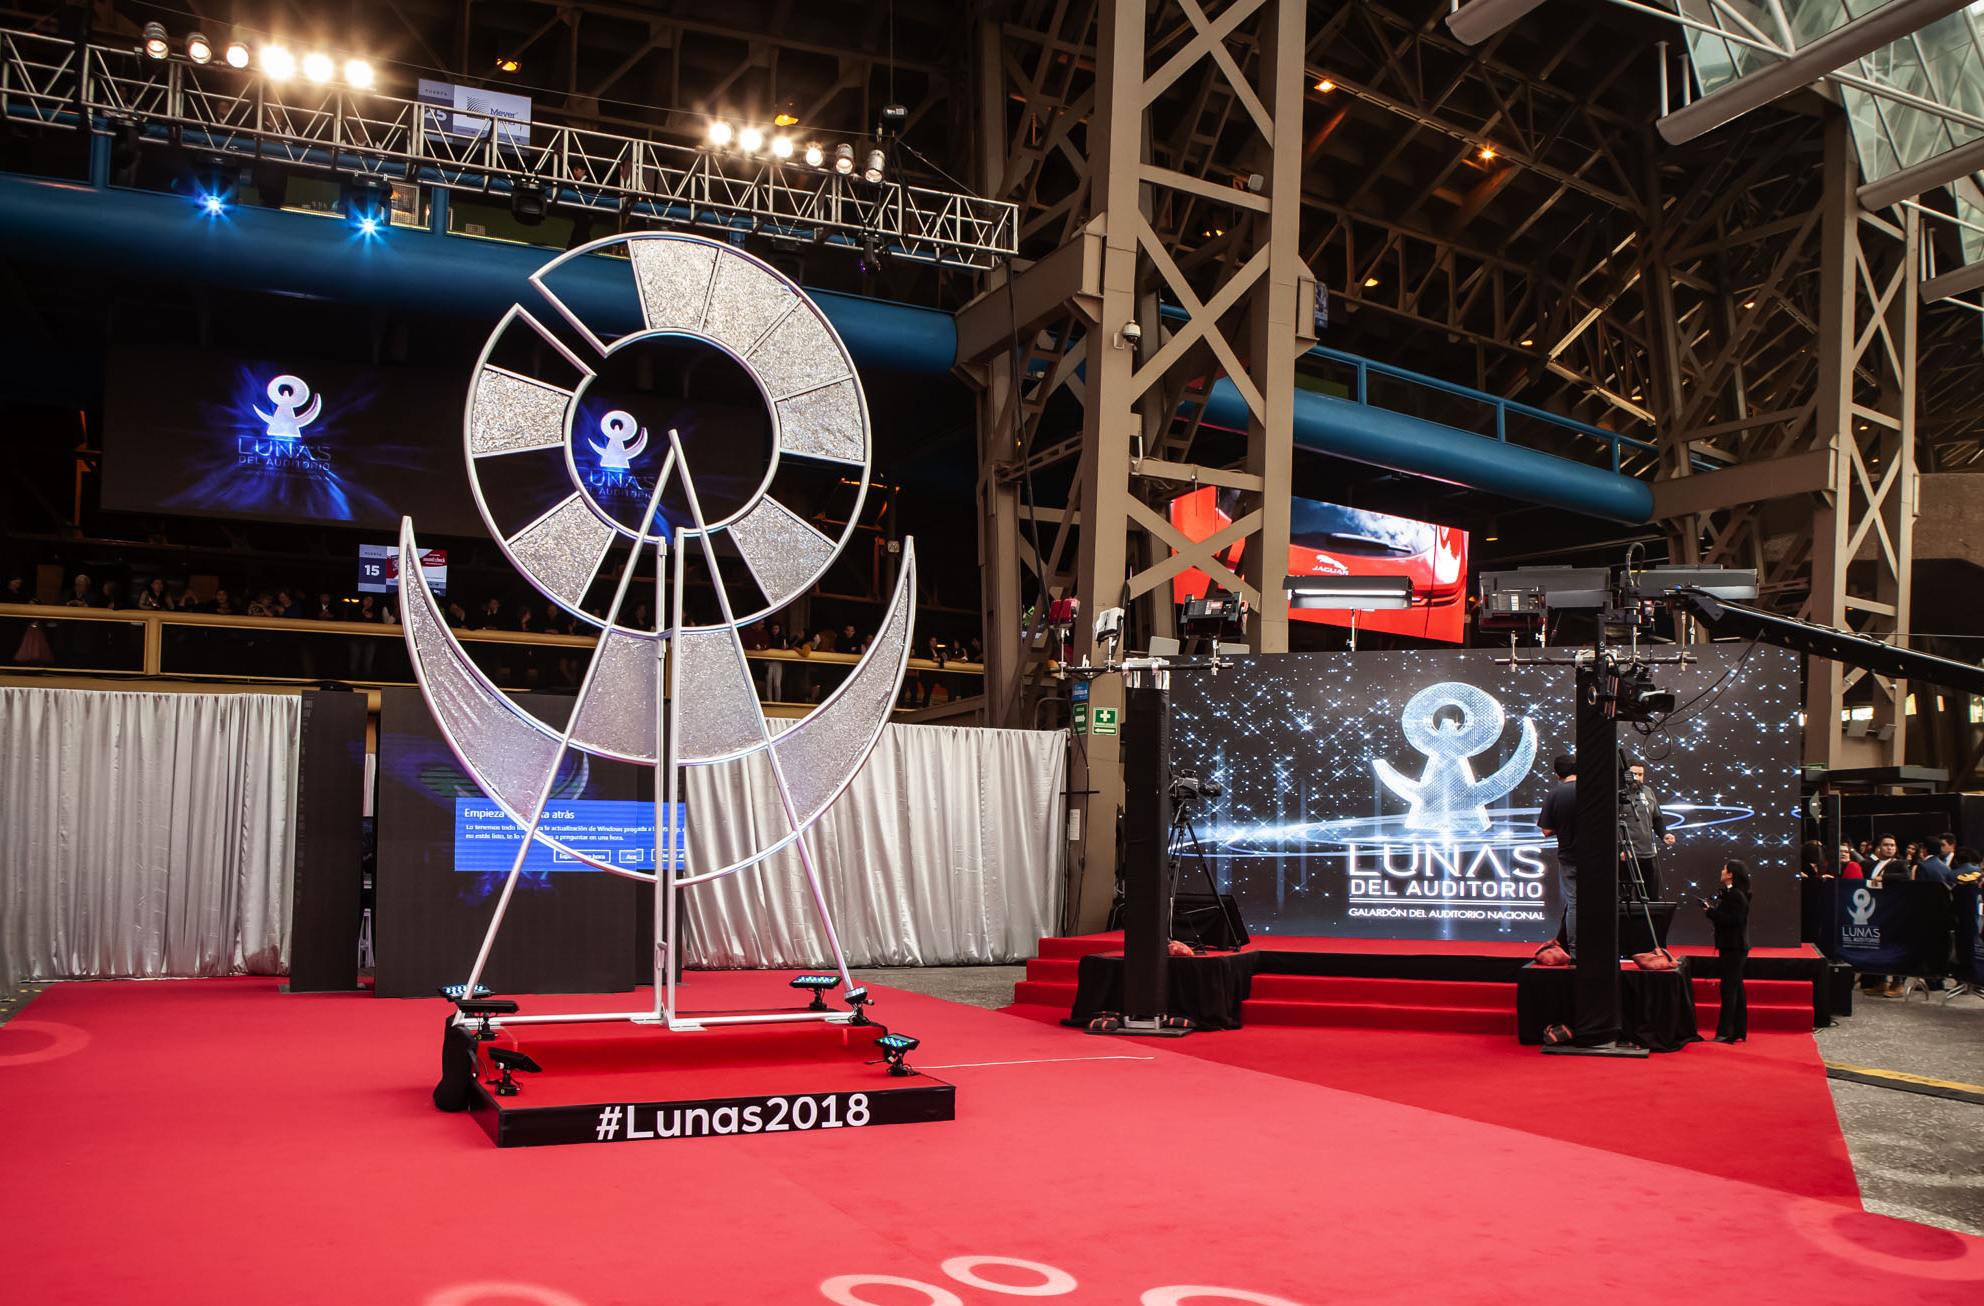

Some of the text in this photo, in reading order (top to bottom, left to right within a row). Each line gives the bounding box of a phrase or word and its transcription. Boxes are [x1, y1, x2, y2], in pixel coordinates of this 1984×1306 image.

[238, 438, 331, 461] LUNAS
[238, 455, 330, 471] DEL AUDITORIO
[581, 470, 656, 491] UNAS
[364, 564, 380, 577] 15
[1312, 565, 1349, 576] JAGUAR
[464, 808, 505, 819] Empieza
[551, 809, 575, 819] atrás
[1349, 842, 1546, 878] LUNAS
[1351, 879, 1544, 898] DEL AUDITORIO
[1348, 906, 1545, 920] GALARDÓN DEL AUDITORIO NACIONAL
[1842, 926, 1880, 937] LUNAS
[596, 1093, 871, 1141] #Lunas2018
